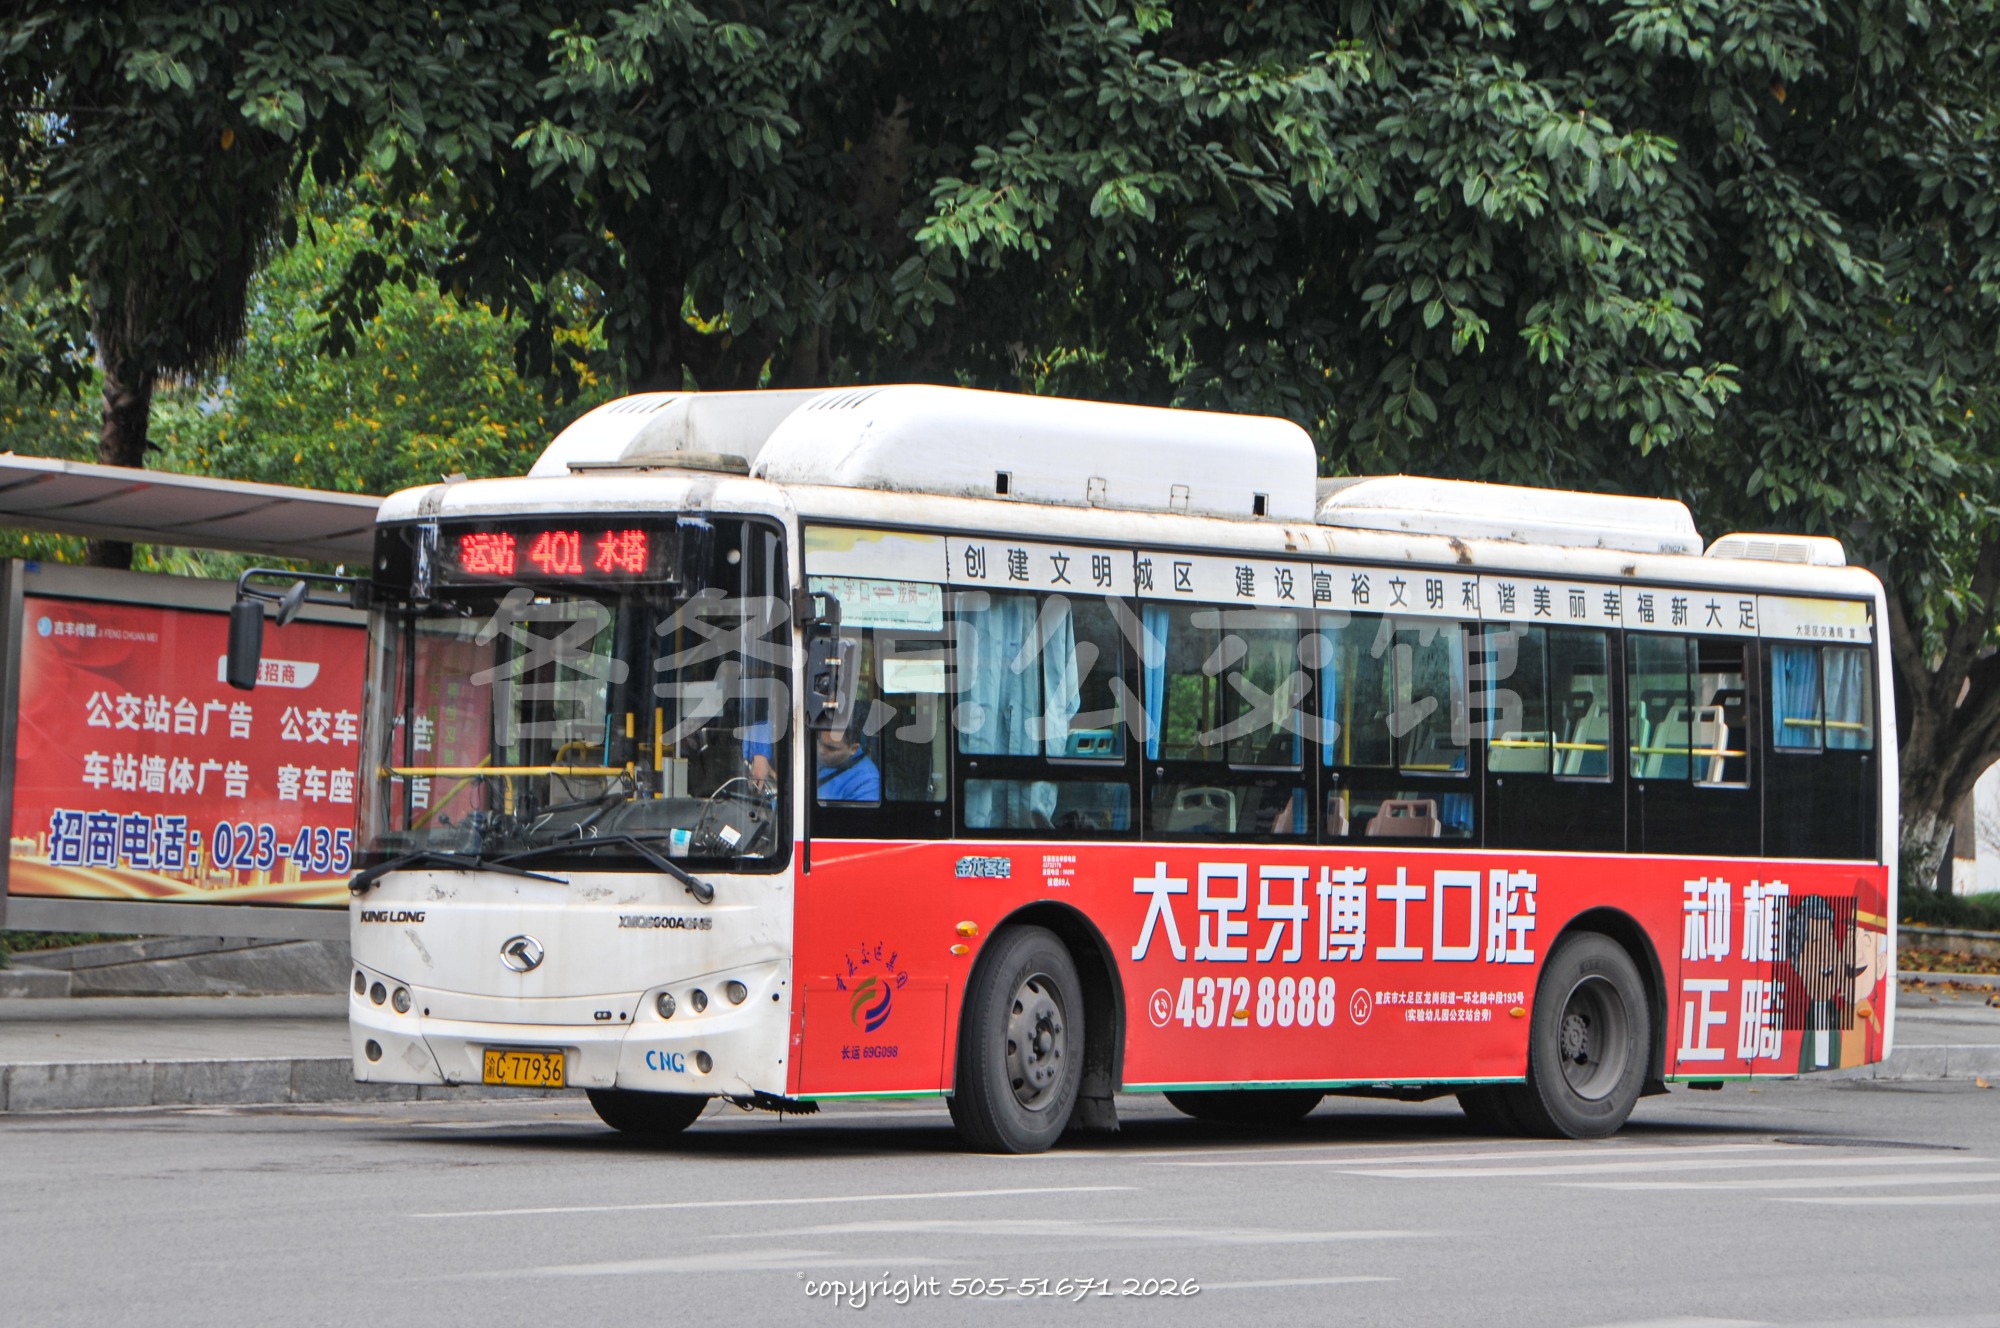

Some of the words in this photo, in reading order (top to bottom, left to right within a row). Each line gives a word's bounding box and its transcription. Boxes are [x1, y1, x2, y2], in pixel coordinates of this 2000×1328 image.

[462, 532, 515, 575] 运站
[532, 531, 584, 574] 401
[596, 530, 648, 574] 水塔
[964, 544, 1194, 593] 创建文明城区
[1235, 565, 1757, 630] 建设富裕文明和谐美丽幸福新大足
[54, 620, 97, 638] 吉丰传媒
[85, 690, 253, 739] 公交站台广告
[280, 706, 358, 746] 公交车
[82, 751, 249, 798] 车站墙体广告
[276, 763, 355, 803] 客车座
[955, 857, 1011, 878] 金龙客车
[361, 910, 388, 923] KING
[389, 910, 426, 923] LONG
[1131, 861, 1537, 964] 大足牙博士口腔
[1682, 876, 1789, 962] 种植
[1256, 976, 1336, 1028] 8888
[1375, 991, 1525, 1005] 重庆市大足区龙岗街道一环北路中段193号
[1677, 978, 1785, 1061] 正畸
[646, 1050, 685, 1073] CNG
[842, 1045, 860, 1060] 长运
[863, 1045, 898, 1059] 69G098
